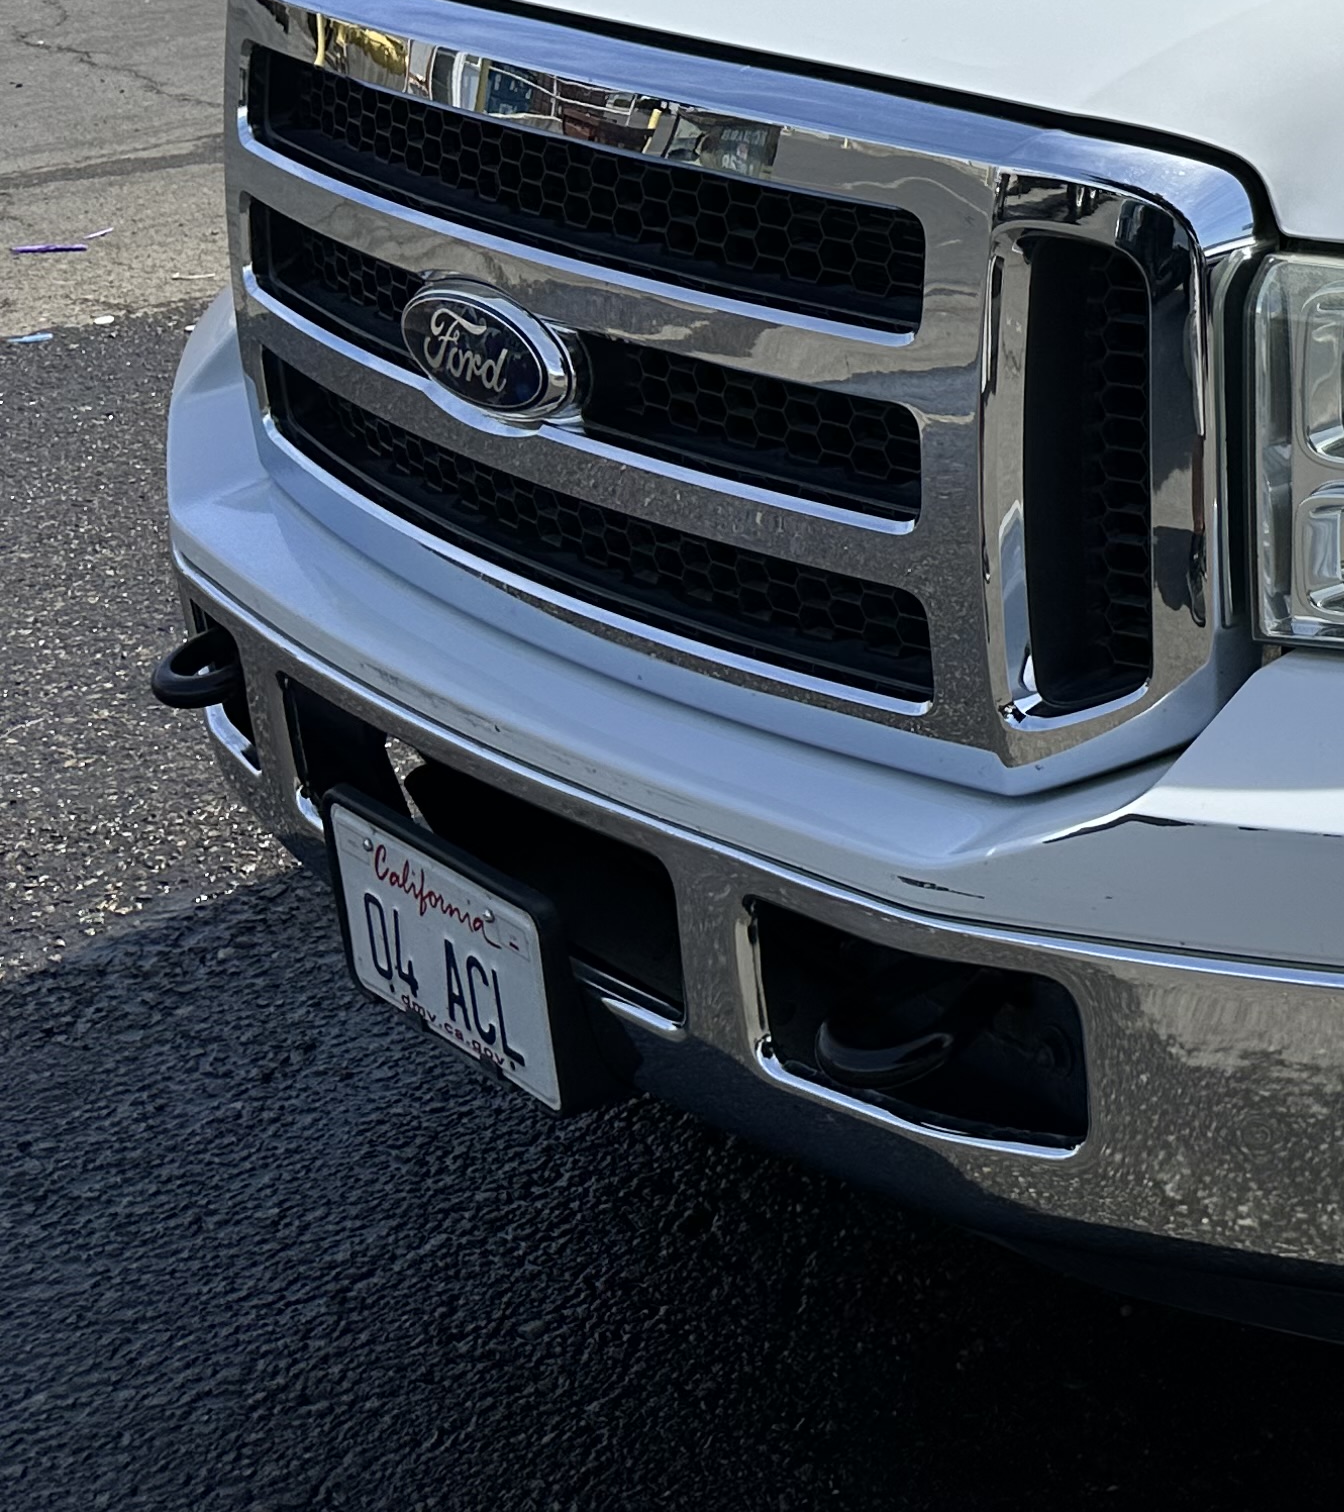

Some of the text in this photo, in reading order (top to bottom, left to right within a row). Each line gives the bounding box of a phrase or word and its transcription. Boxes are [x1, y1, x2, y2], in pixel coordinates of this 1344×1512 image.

[423, 307, 509, 393] Ford
[373, 843, 502, 949] California
[363, 892, 526, 1067] 04 ACL
[401, 994, 505, 1066] dmv.ca.gov
